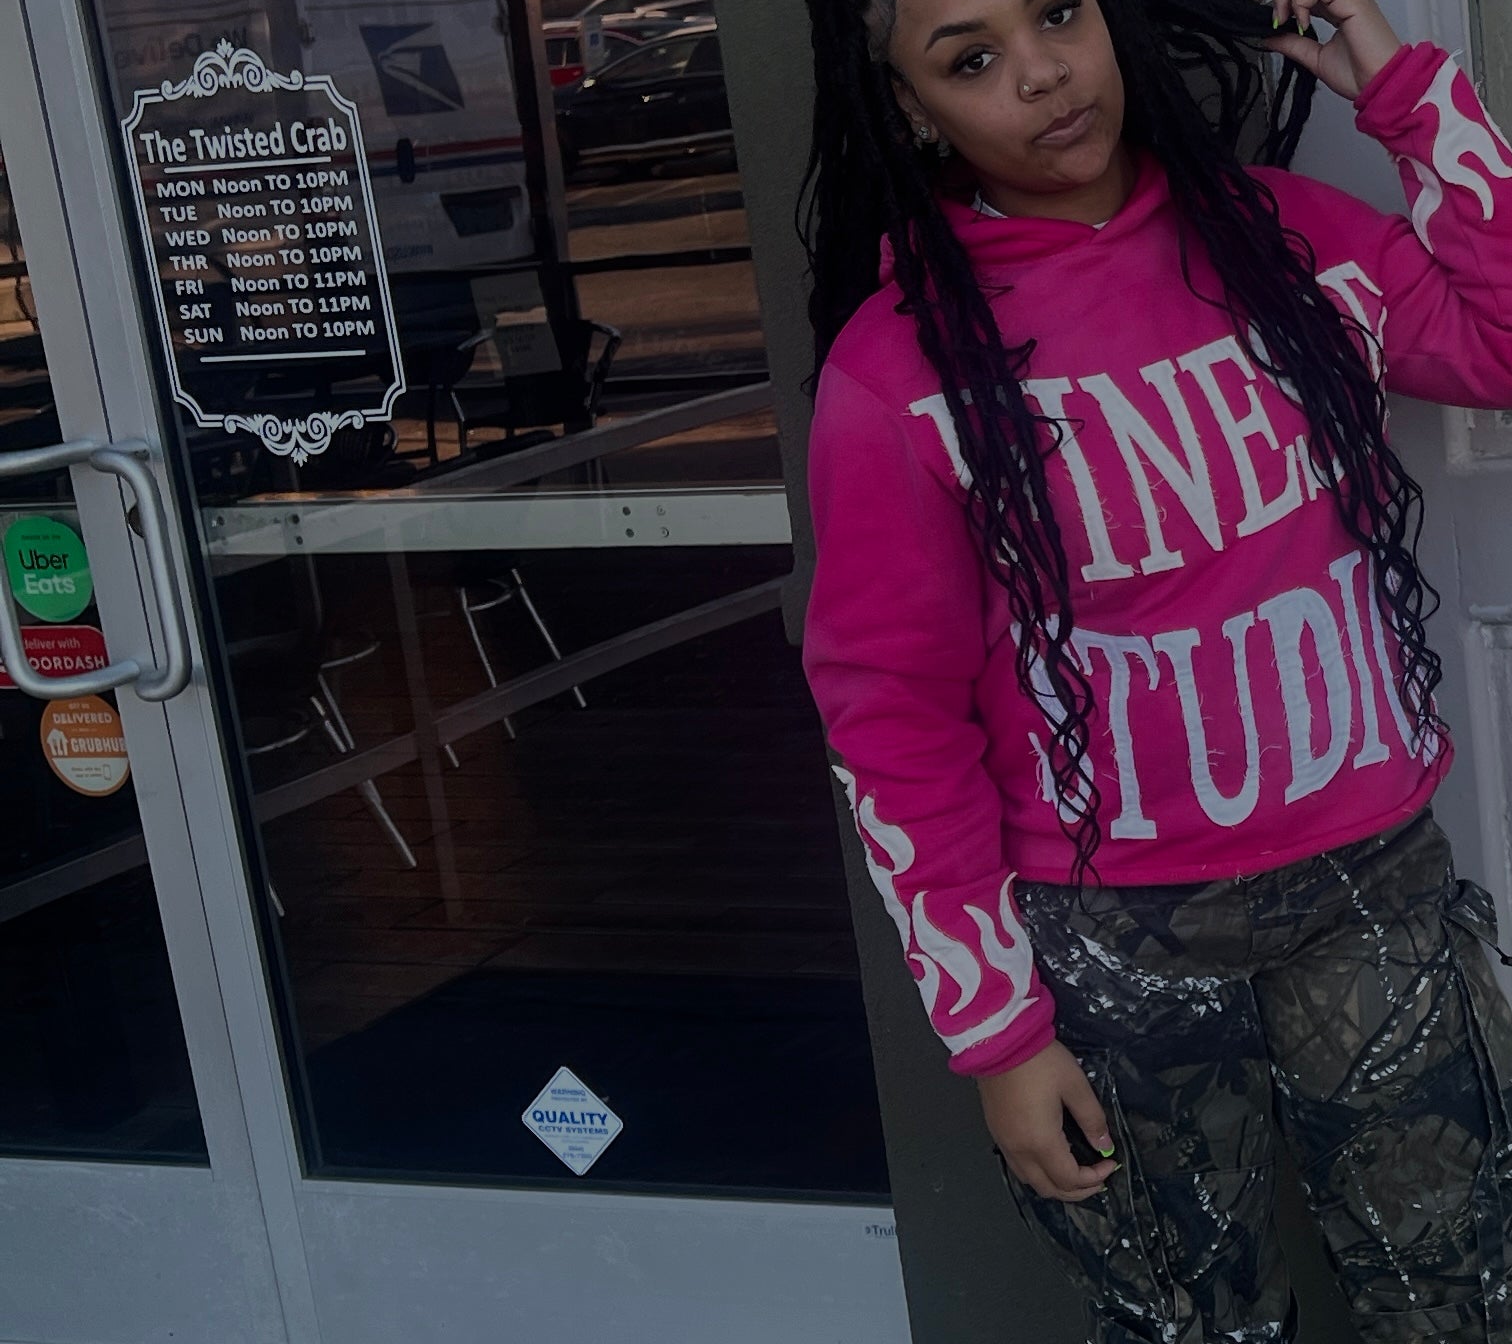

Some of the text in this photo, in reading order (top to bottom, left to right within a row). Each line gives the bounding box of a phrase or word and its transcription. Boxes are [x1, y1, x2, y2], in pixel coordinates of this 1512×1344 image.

[139, 130, 187, 164] The
[189, 121, 286, 160] Twisted
[290, 117, 347, 154] Crab
[156, 170, 349, 198] MON Noon TO 10PM
[160, 195, 353, 223] TUE Noon TO 10PM
[165, 220, 358, 247] WED Noon TO 10PM
[169, 245, 362, 271] THR Noon TO 10PM
[175, 270, 367, 296] FRI Noon TO 11PM
[179, 295, 371, 320] SAT Noon TO 11PM
[184, 319, 376, 344] SUN Noon TO 10PM
[18, 549, 69, 570] Uber
[23, 573, 76, 595] Eats
[57, 636, 81, 649] with
[29, 656, 105, 672] OORDASH
[53, 711, 113, 725] DELIVERED
[532, 1110, 607, 1126] QUALITY
[538, 1125, 609, 1135] CCTV SYSTEMS
